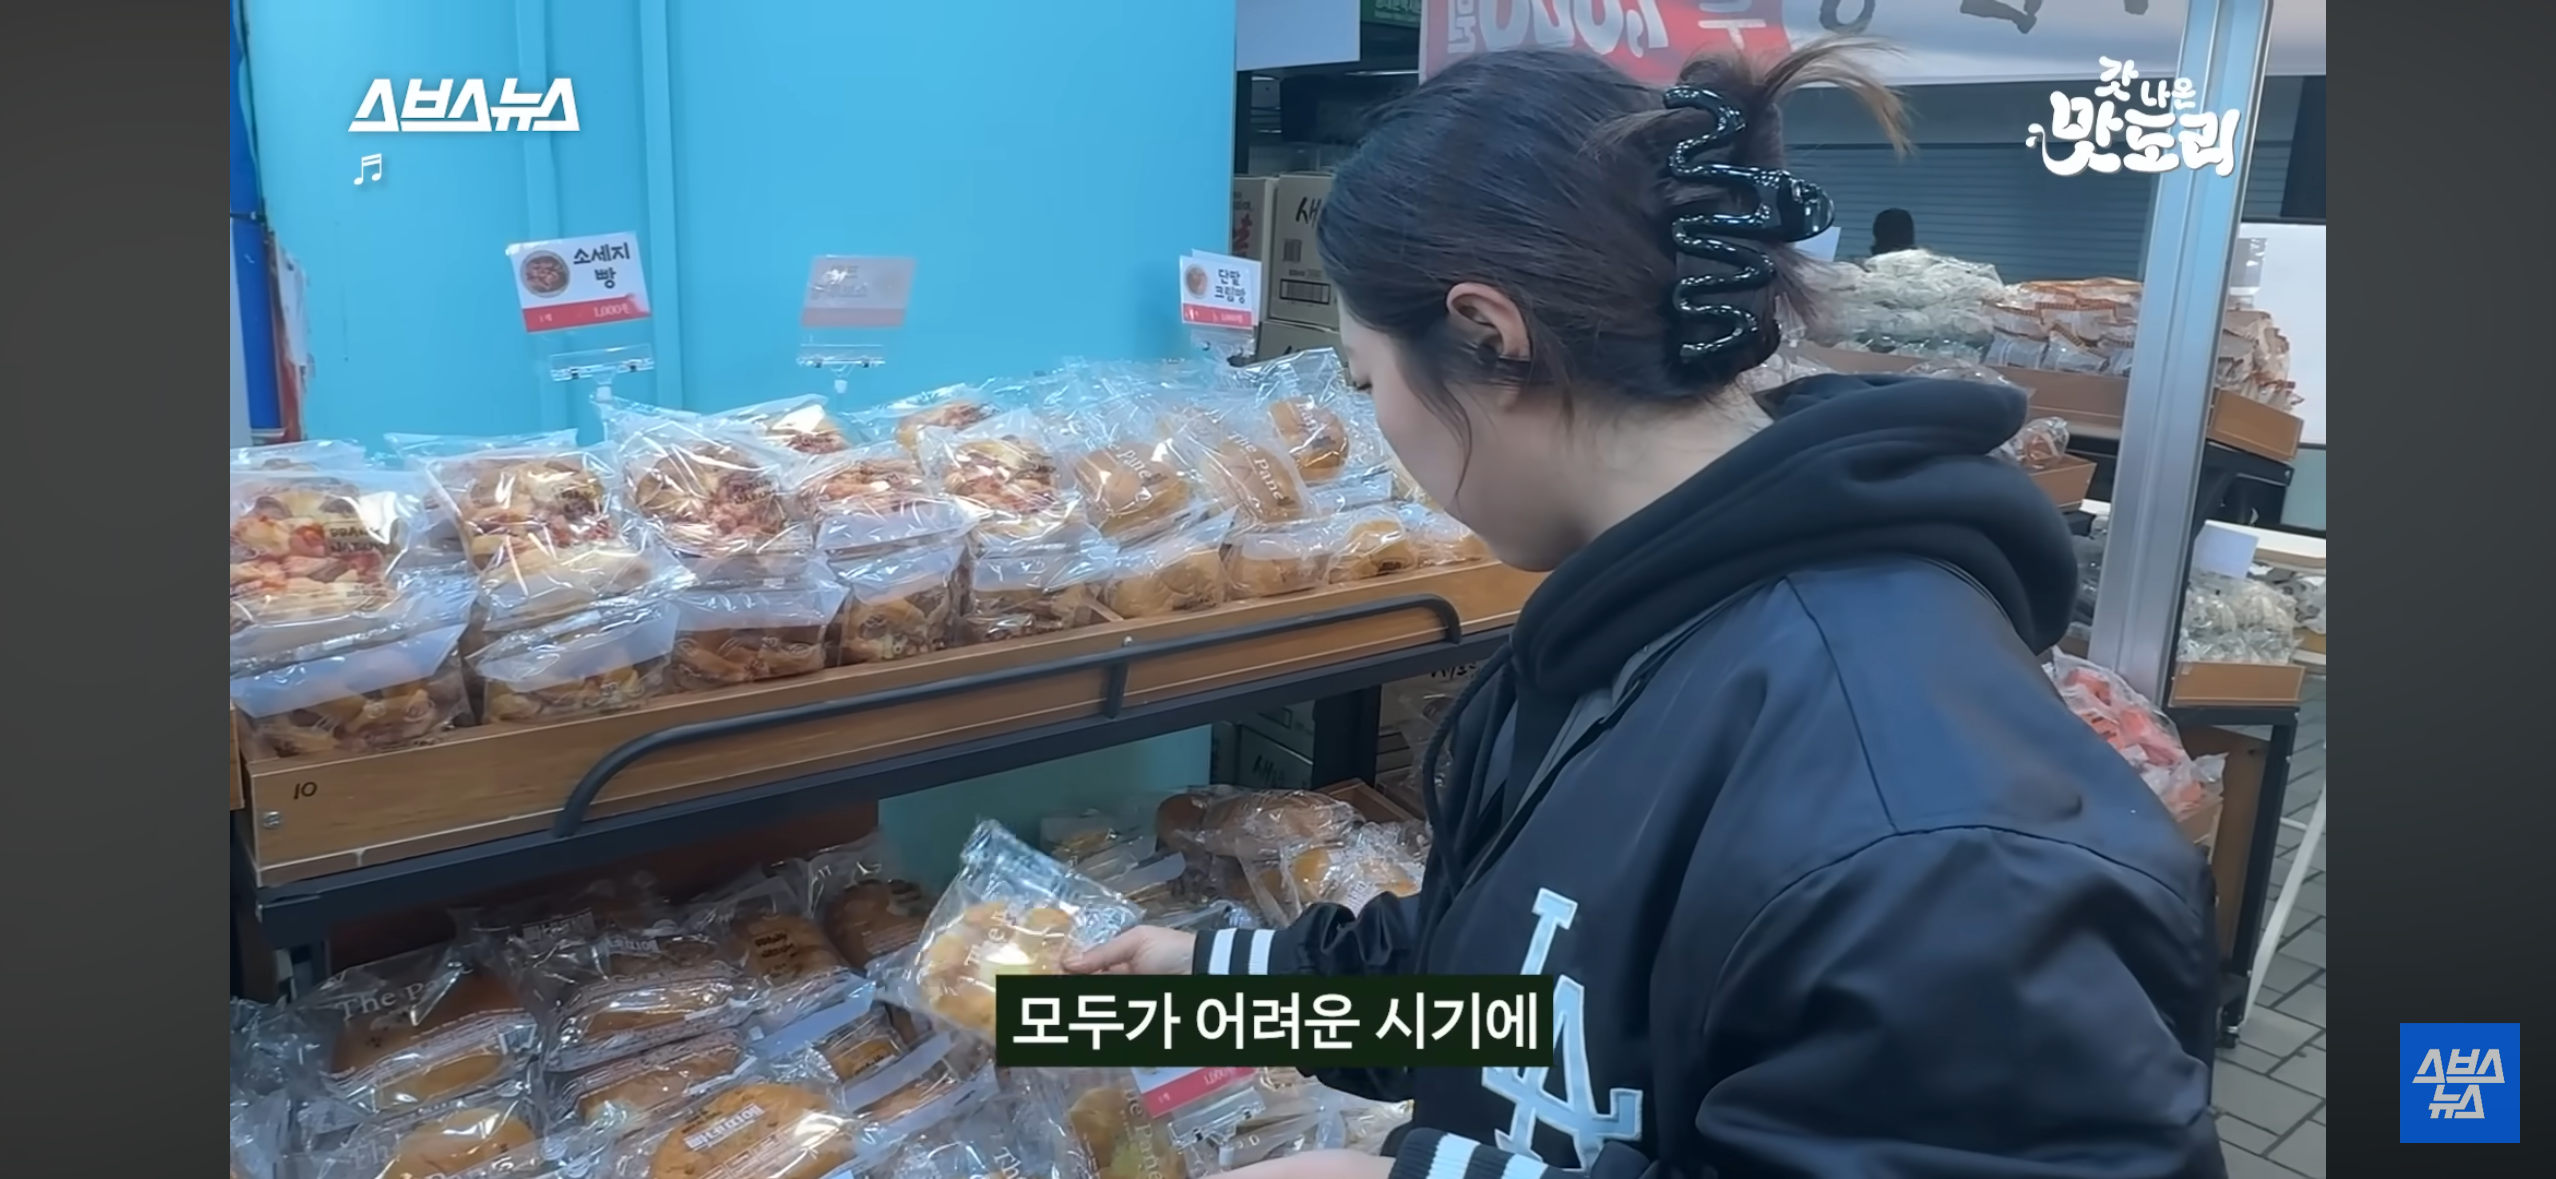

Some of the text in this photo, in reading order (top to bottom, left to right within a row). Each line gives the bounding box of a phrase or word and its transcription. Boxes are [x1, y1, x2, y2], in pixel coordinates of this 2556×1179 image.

[573, 242, 631, 265] 소세지
[594, 267, 617, 289] 빵
[1227, 432, 1285, 500] The Pane
[293, 781, 318, 800] 10
[334, 989, 398, 1022] The
